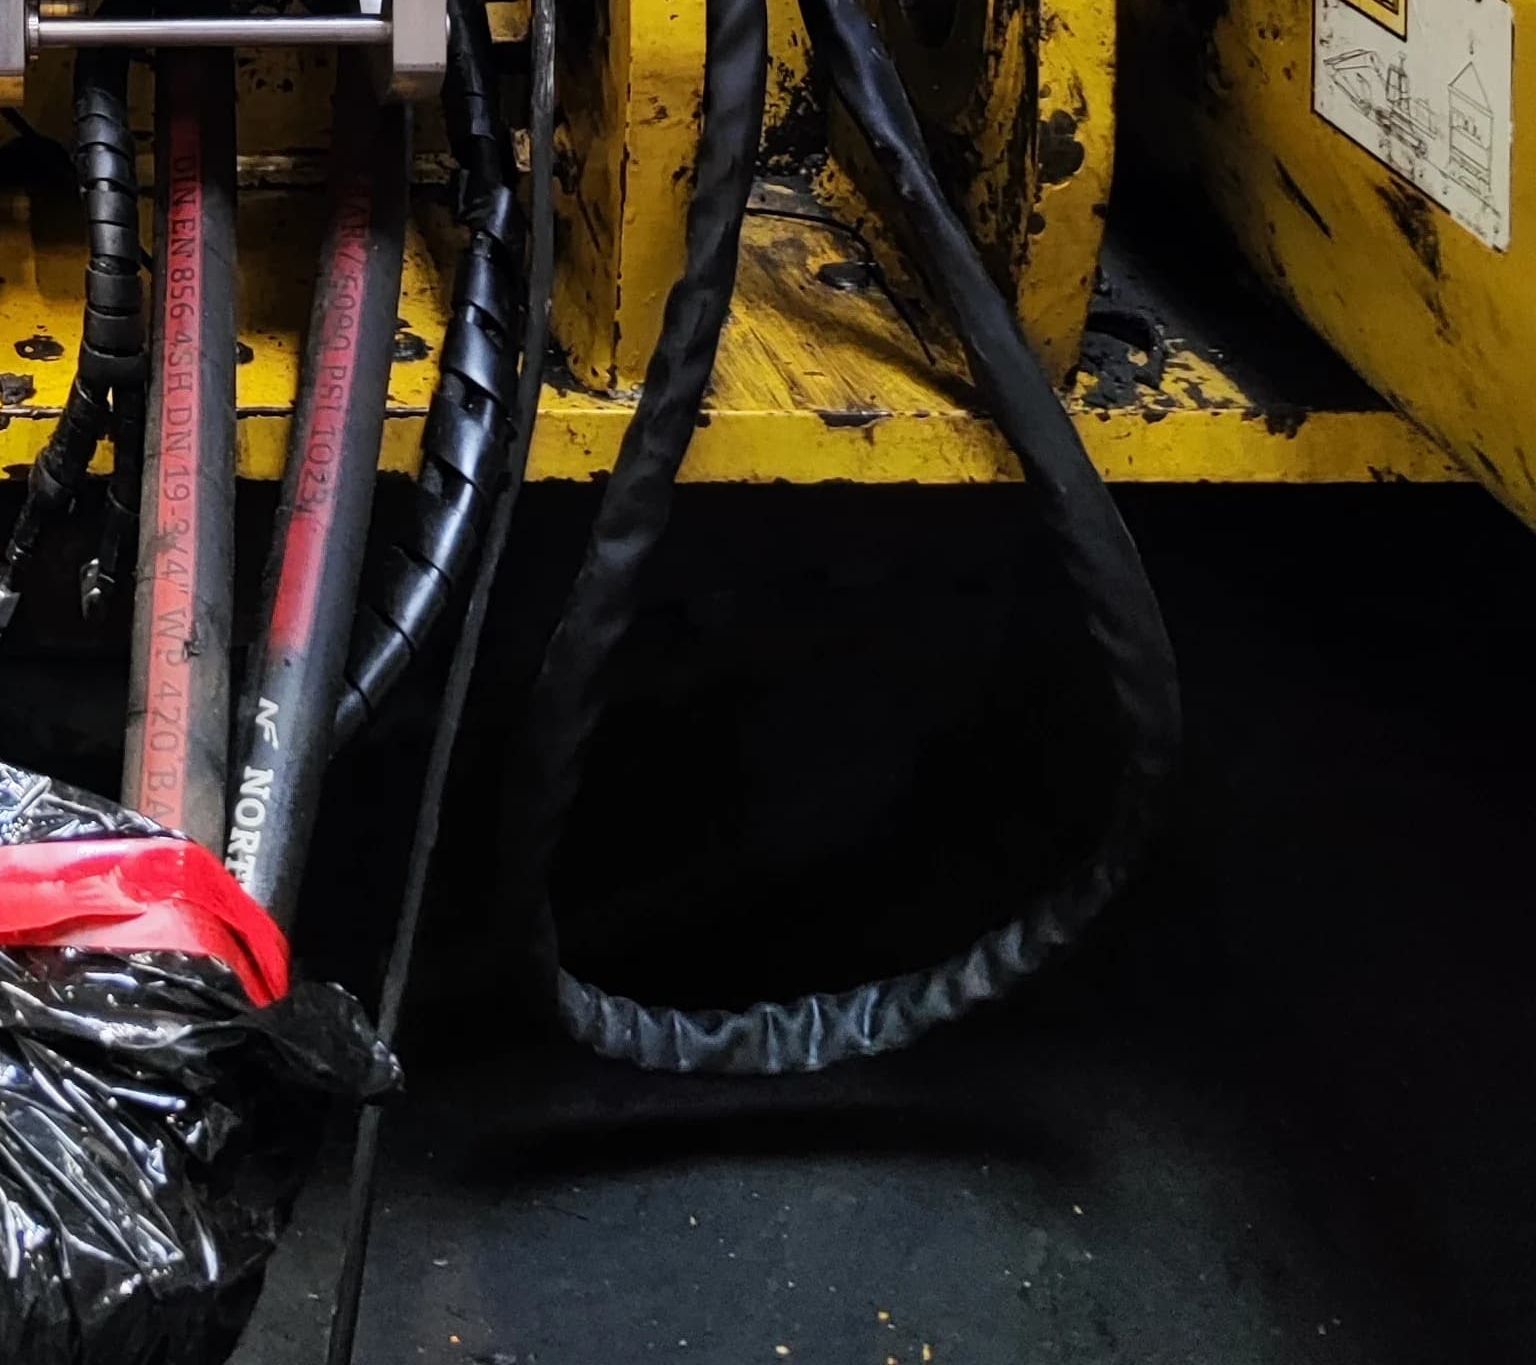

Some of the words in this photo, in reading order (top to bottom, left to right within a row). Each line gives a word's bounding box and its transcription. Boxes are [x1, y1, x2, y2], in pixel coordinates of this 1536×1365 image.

[172, 217, 197, 262] EN
[170, 268, 195, 320] 856
[166, 330, 194, 395] 4SH
[318, 364, 348, 413] PSI
[150, 680, 182, 753] 420
[146, 768, 178, 822] BA
[225, 765, 275, 891] NORT
